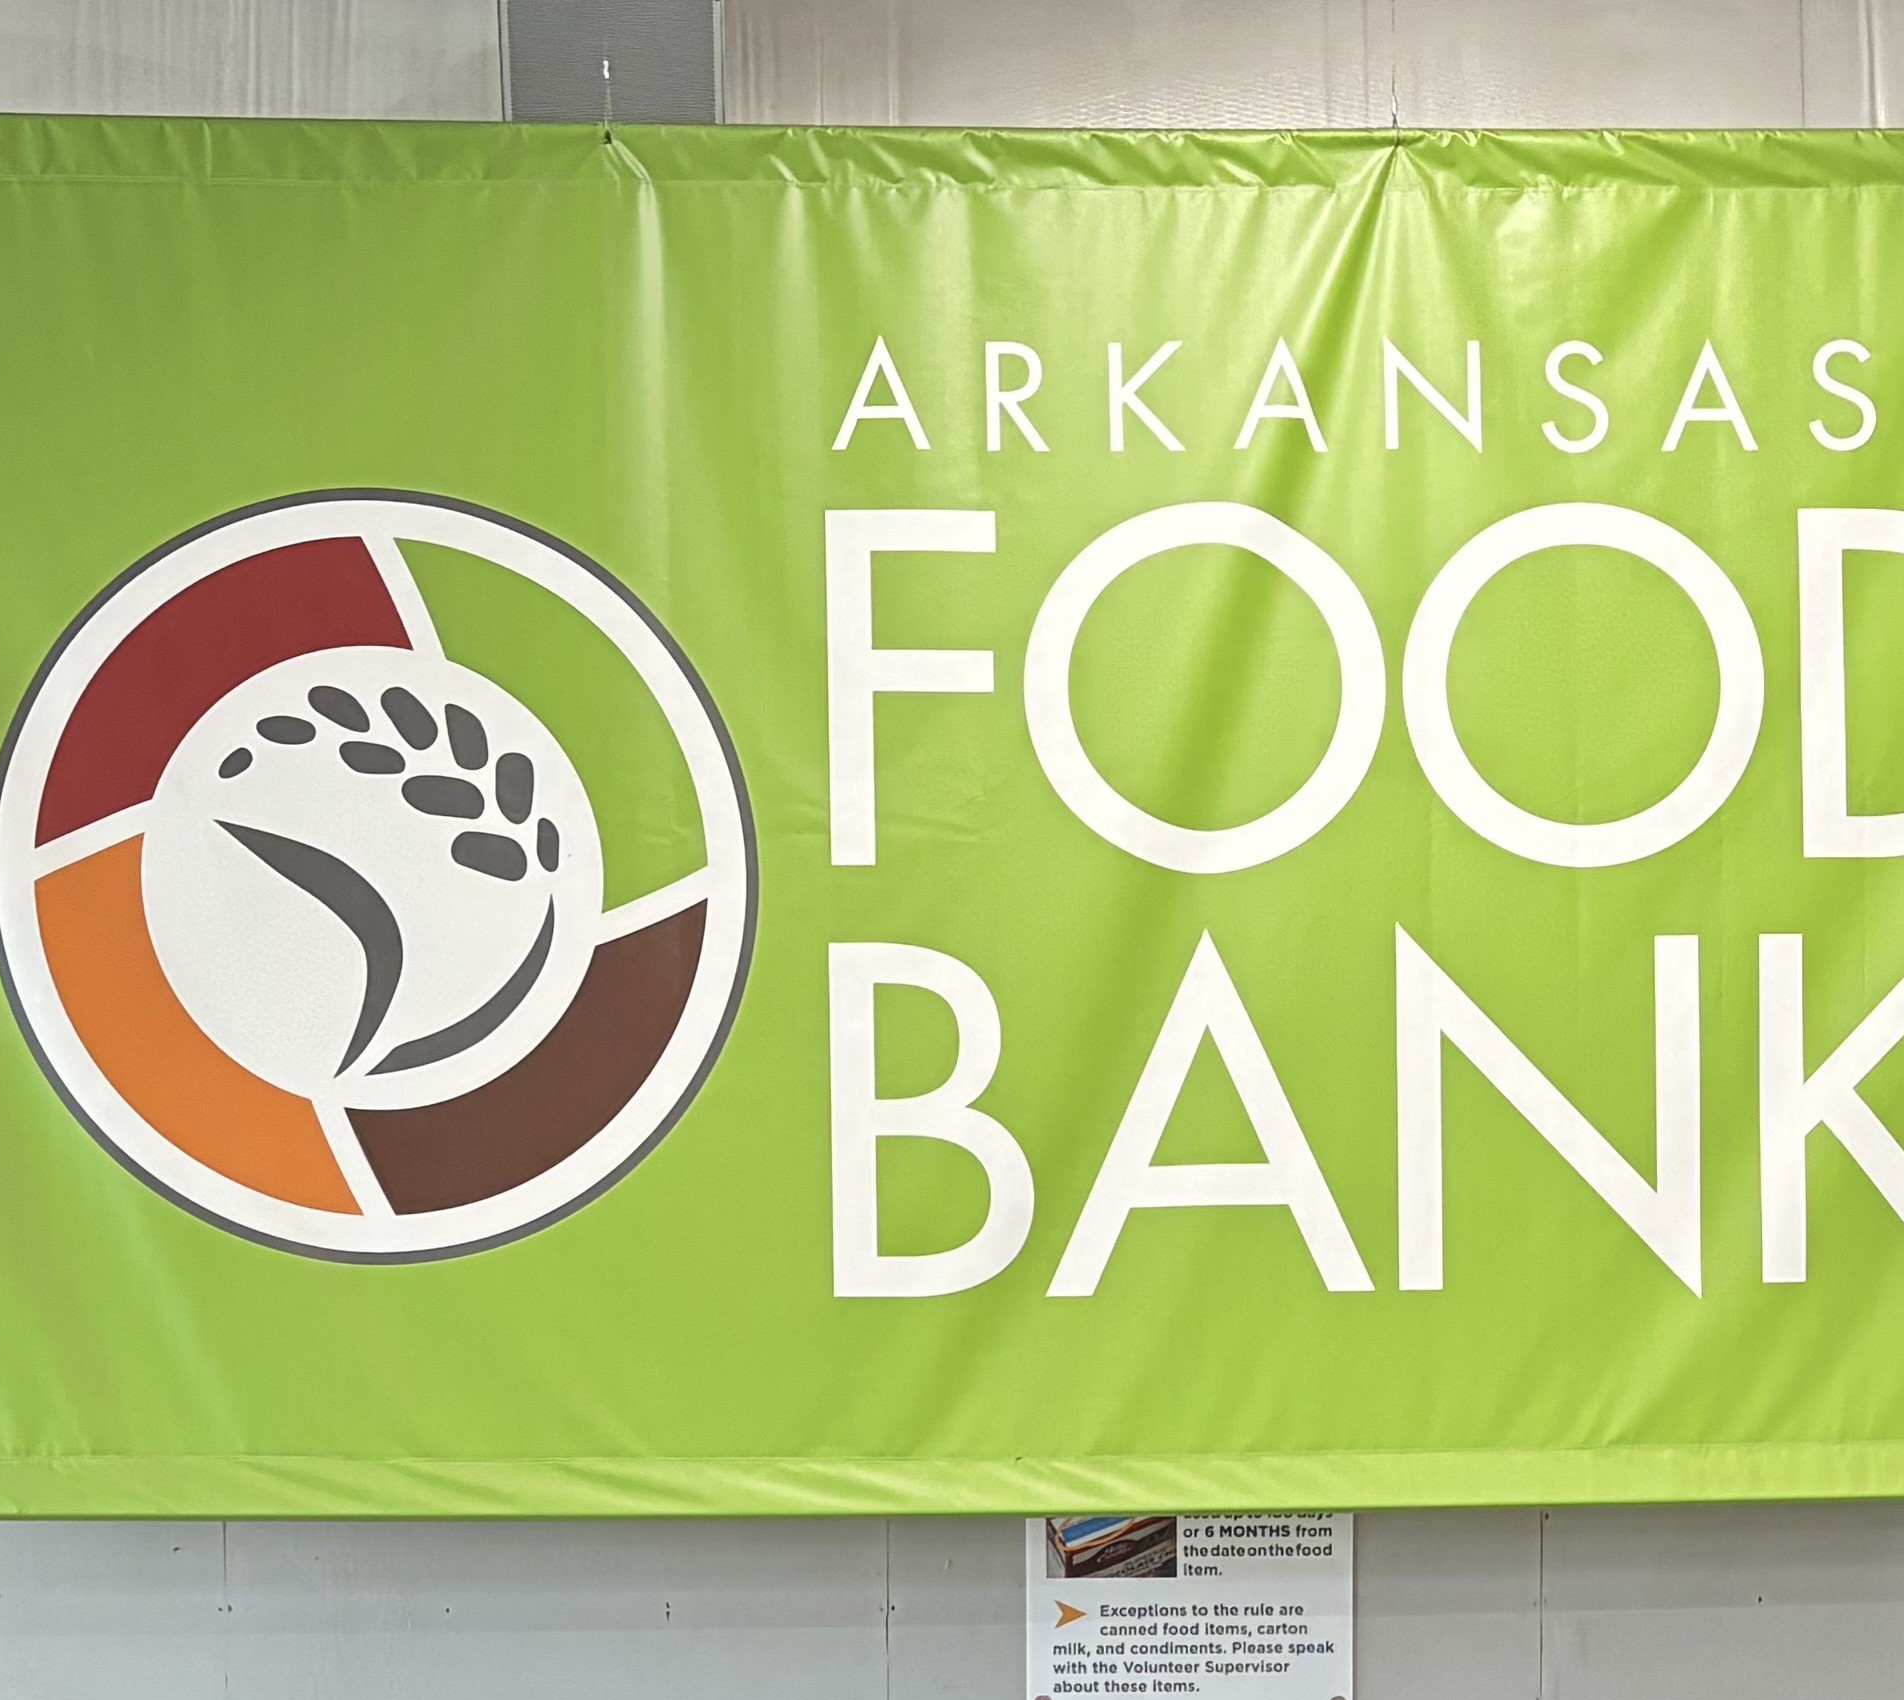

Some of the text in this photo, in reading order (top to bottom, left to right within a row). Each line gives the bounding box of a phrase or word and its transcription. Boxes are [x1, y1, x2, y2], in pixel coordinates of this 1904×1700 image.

[831, 336, 1879, 455] ARKANSAS
[1183, 1525, 1333, 1538] or 6 MONTHS from
[1183, 1544, 1333, 1557] the date on the food
[1183, 1563, 1223, 1576] item.
[1100, 1604, 1304, 1620] Exceptions to the rule are
[1100, 1623, 1308, 1638] canned food items, carton
[1053, 1642, 1335, 1658] milk, and condiments. Please speak
[1053, 1660, 1289, 1676] with the Volunteer Supervisor
[1053, 1680, 1200, 1693] about these items.
